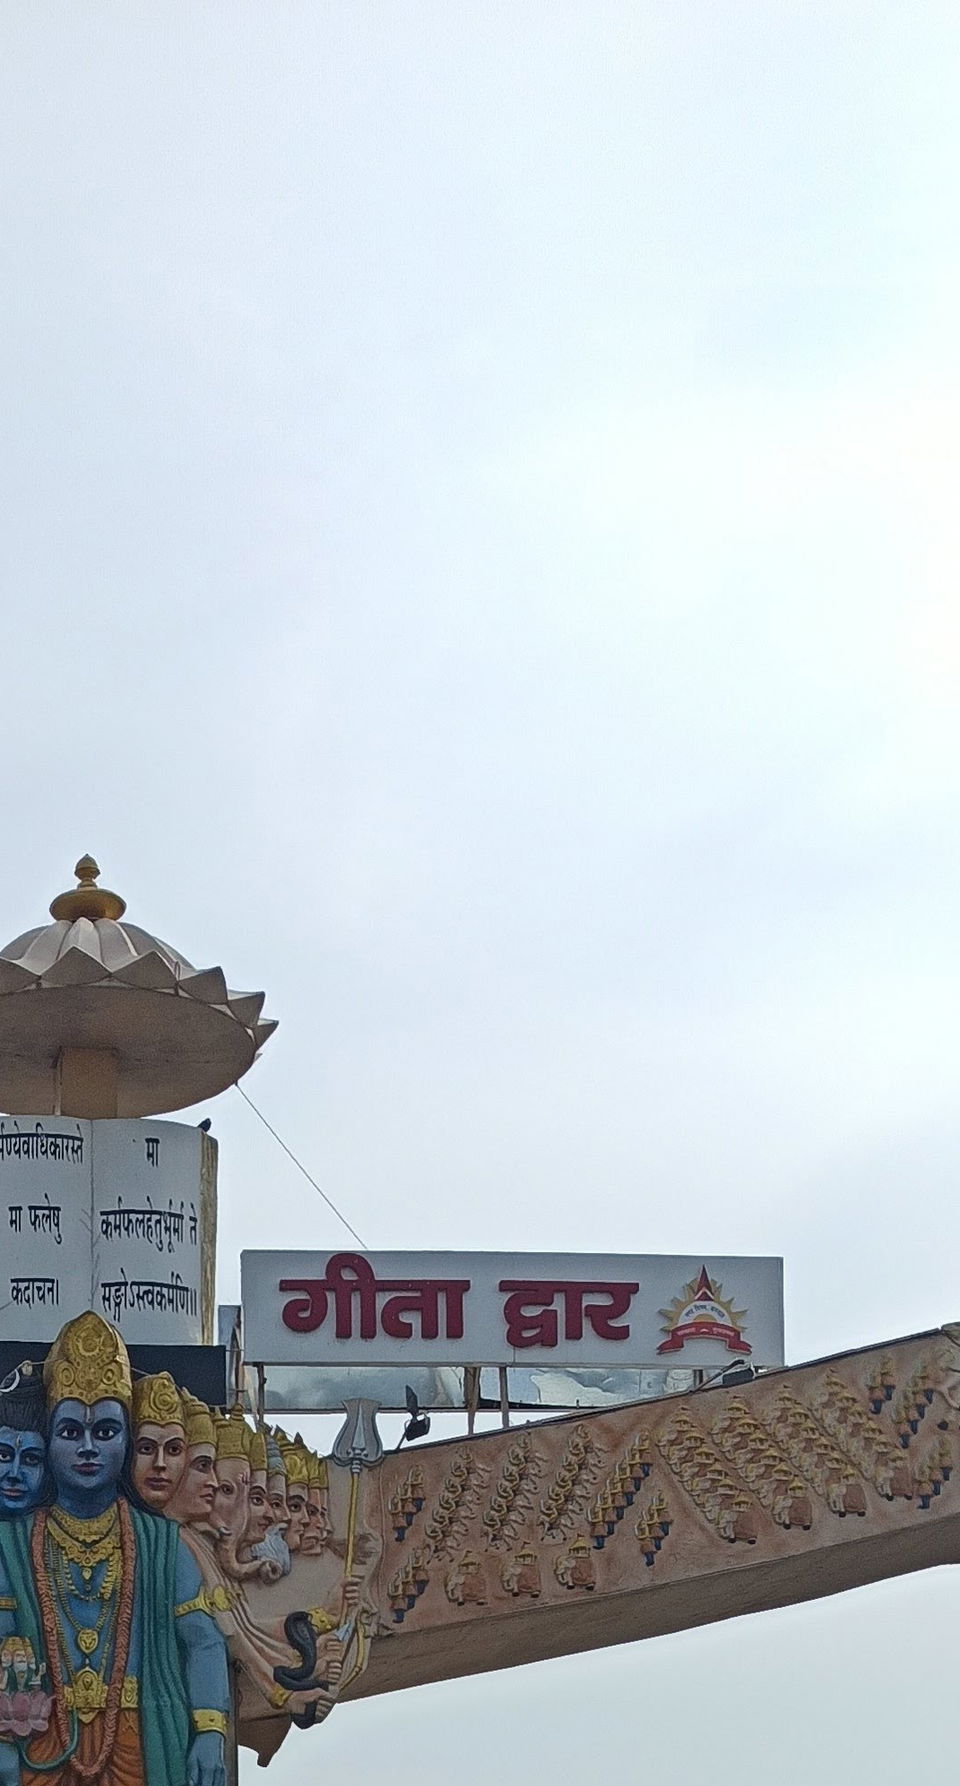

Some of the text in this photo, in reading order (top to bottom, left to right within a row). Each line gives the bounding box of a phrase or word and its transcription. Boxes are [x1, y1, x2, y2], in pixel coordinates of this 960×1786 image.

[145, 1137, 160, 1167] मा
[8, 1193, 62, 1244] मा फलेषु
[99, 1196, 198, 1254] कर्मफलहेतुर्भूर्मा ते
[279, 1252, 640, 1349] गीता द्वार
